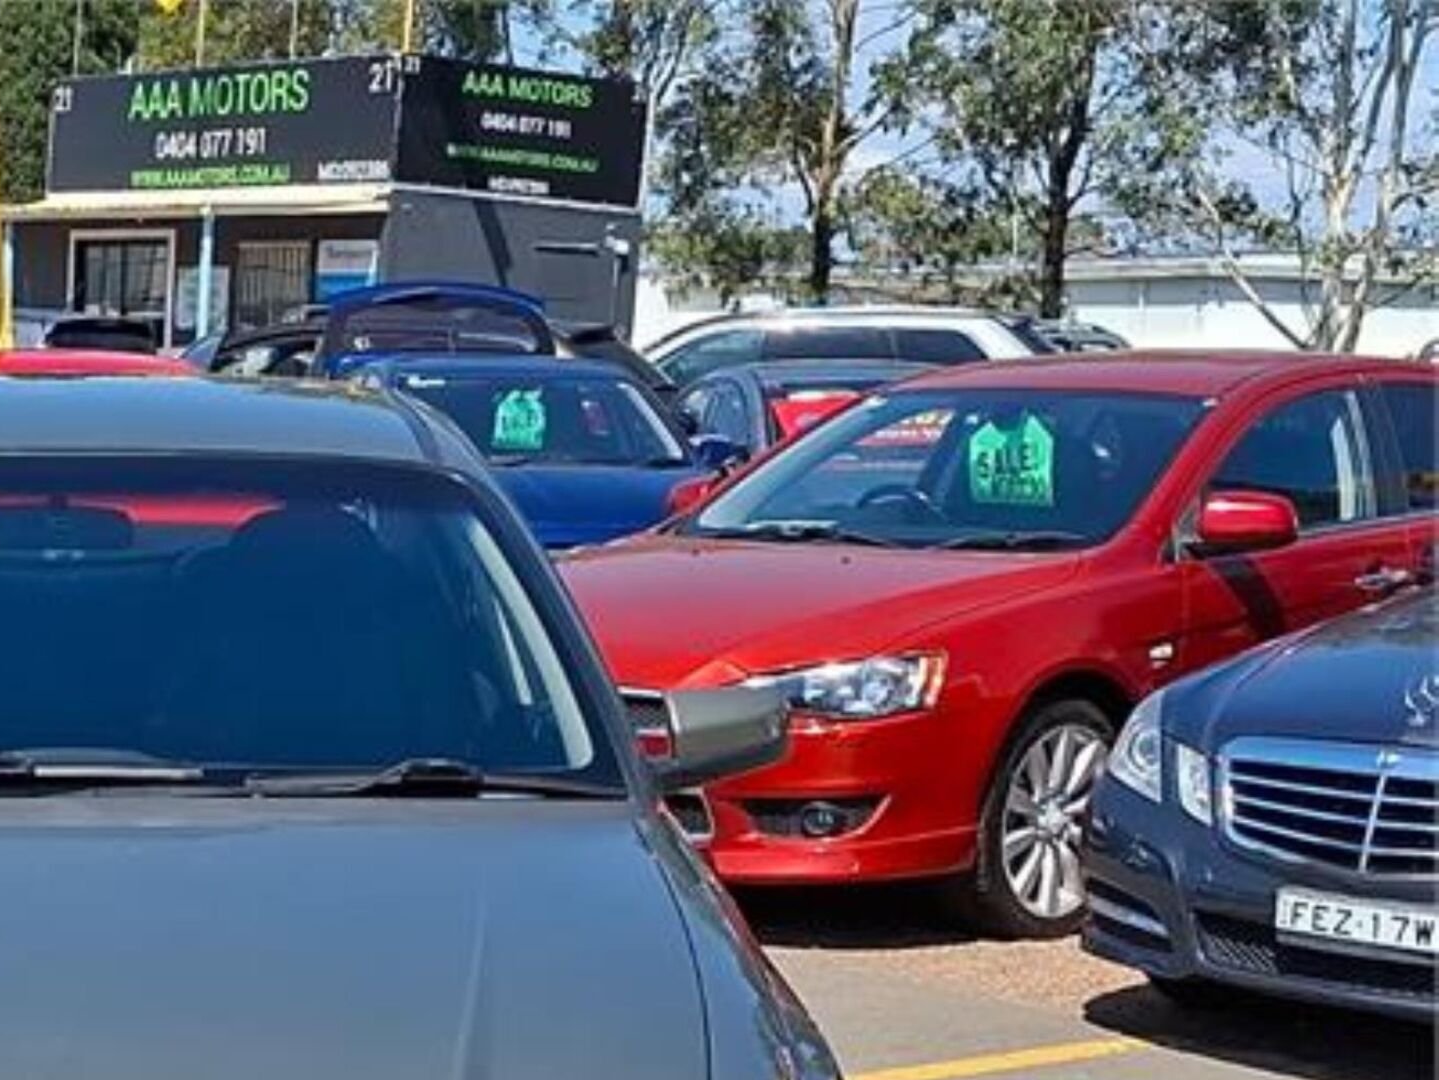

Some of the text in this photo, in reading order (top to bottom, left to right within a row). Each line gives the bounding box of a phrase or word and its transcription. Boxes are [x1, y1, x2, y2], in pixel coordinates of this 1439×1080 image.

[127, 70, 310, 121] AAA MOTORS
[368, 63, 394, 94] 21
[462, 70, 594, 108] AAA MOTORS
[156, 131, 197, 159] 0404
[235, 127, 266, 155] 191
